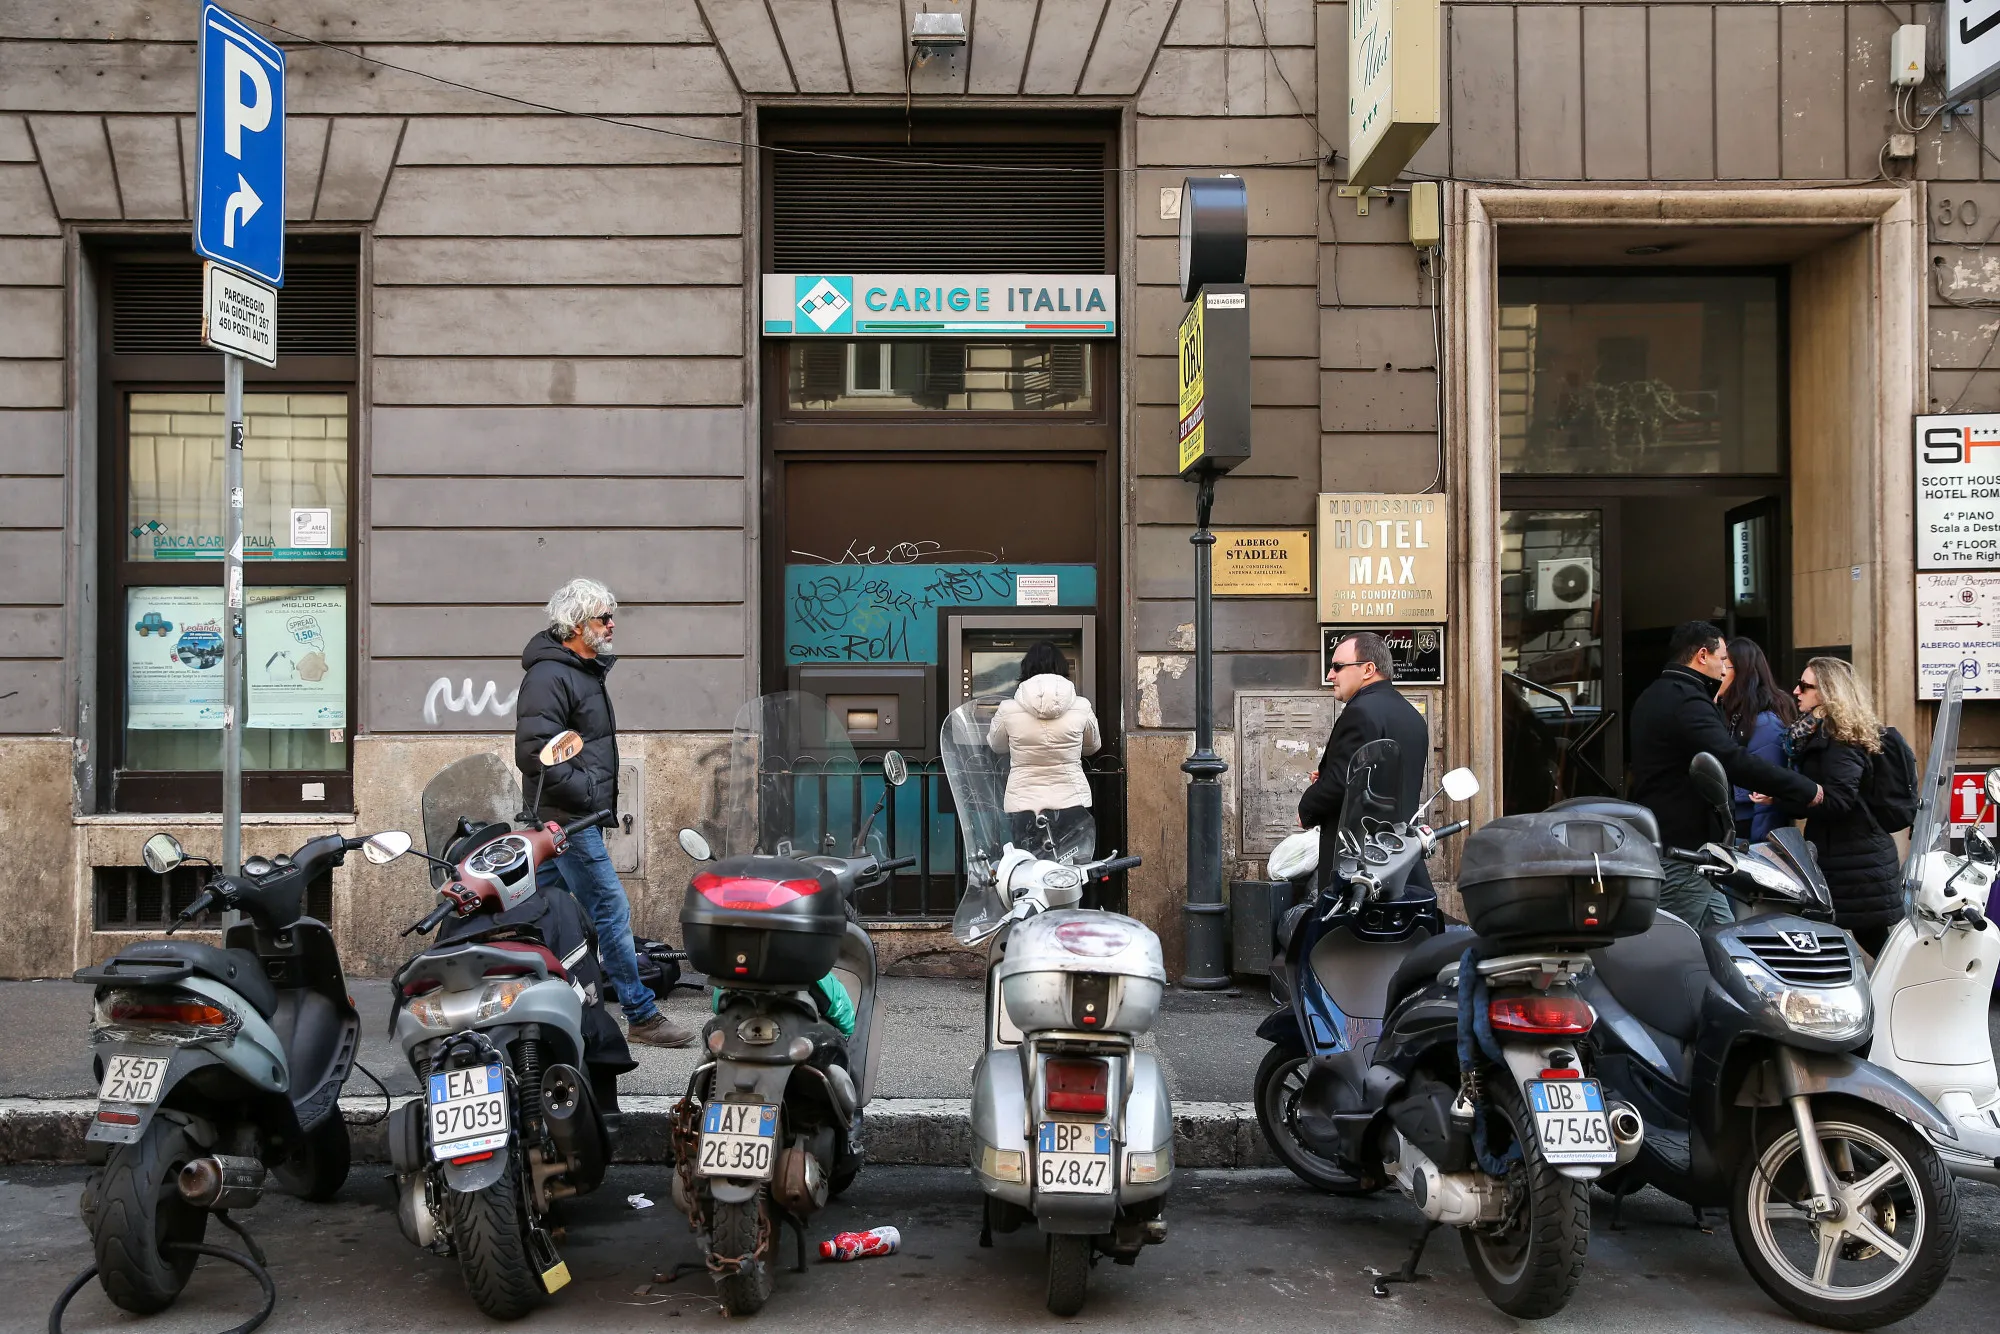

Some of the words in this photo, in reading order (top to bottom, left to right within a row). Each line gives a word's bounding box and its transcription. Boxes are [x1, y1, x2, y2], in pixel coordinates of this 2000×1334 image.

[224, 38, 272, 160] P
[1938, 198, 1978, 226] 30
[224, 286, 265, 314] PARCHEGGIO
[864, 287, 990, 312] CARIGE
[1008, 287, 1106, 312] ITALIA
[218, 300, 230, 314] VIA
[231, 306, 258, 326] GIOLITTI
[258, 316, 270, 330] 267
[218, 316, 232, 331] 450
[232, 322, 252, 339] POSTI
[252, 330, 269, 346] AUTO
[1184, 324, 1202, 390] ORO
[1921, 476, 1964, 486] SCOTT
[1925, 490, 1967, 500] HOTEL
[1970, 488, 2000, 499] ROM
[1330, 500, 1434, 514] NUOVISSIMO
[1958, 511, 1994, 521] PIANO
[1334, 520, 1430, 549] HOTEL
[1930, 524, 1960, 533] Scala
[153, 536, 195, 548] BANCA
[196, 536, 224, 548] CARI
[243, 536, 276, 548] ITALIA
[1956, 540, 1997, 549] FLOOR
[1226, 550, 1288, 560] STADLER
[1933, 552, 1949, 561] On
[1952, 552, 1973, 561] The
[1348, 556, 1416, 585] MAX
[1928, 575, 1959, 587] Hotel
[1334, 590, 1356, 600] ARIA
[1361, 590, 1433, 600] CONDIZIONATA
[1351, 602, 1394, 616] PIANO
[180, 622, 222, 634] Leolandia
[289, 618, 314, 630] SPREAD
[114, 1059, 158, 1079] X5D
[108, 1079, 152, 1100] ZND
[448, 1070, 475, 1099] EA
[1546, 1084, 1574, 1110] DB
[436, 1100, 502, 1135] 97039
[721, 1106, 748, 1132] AY
[1057, 1124, 1082, 1151] BP
[1544, 1118, 1607, 1145] 47546
[702, 1140, 770, 1170] 26930
[1042, 1159, 1106, 1186] 64847
